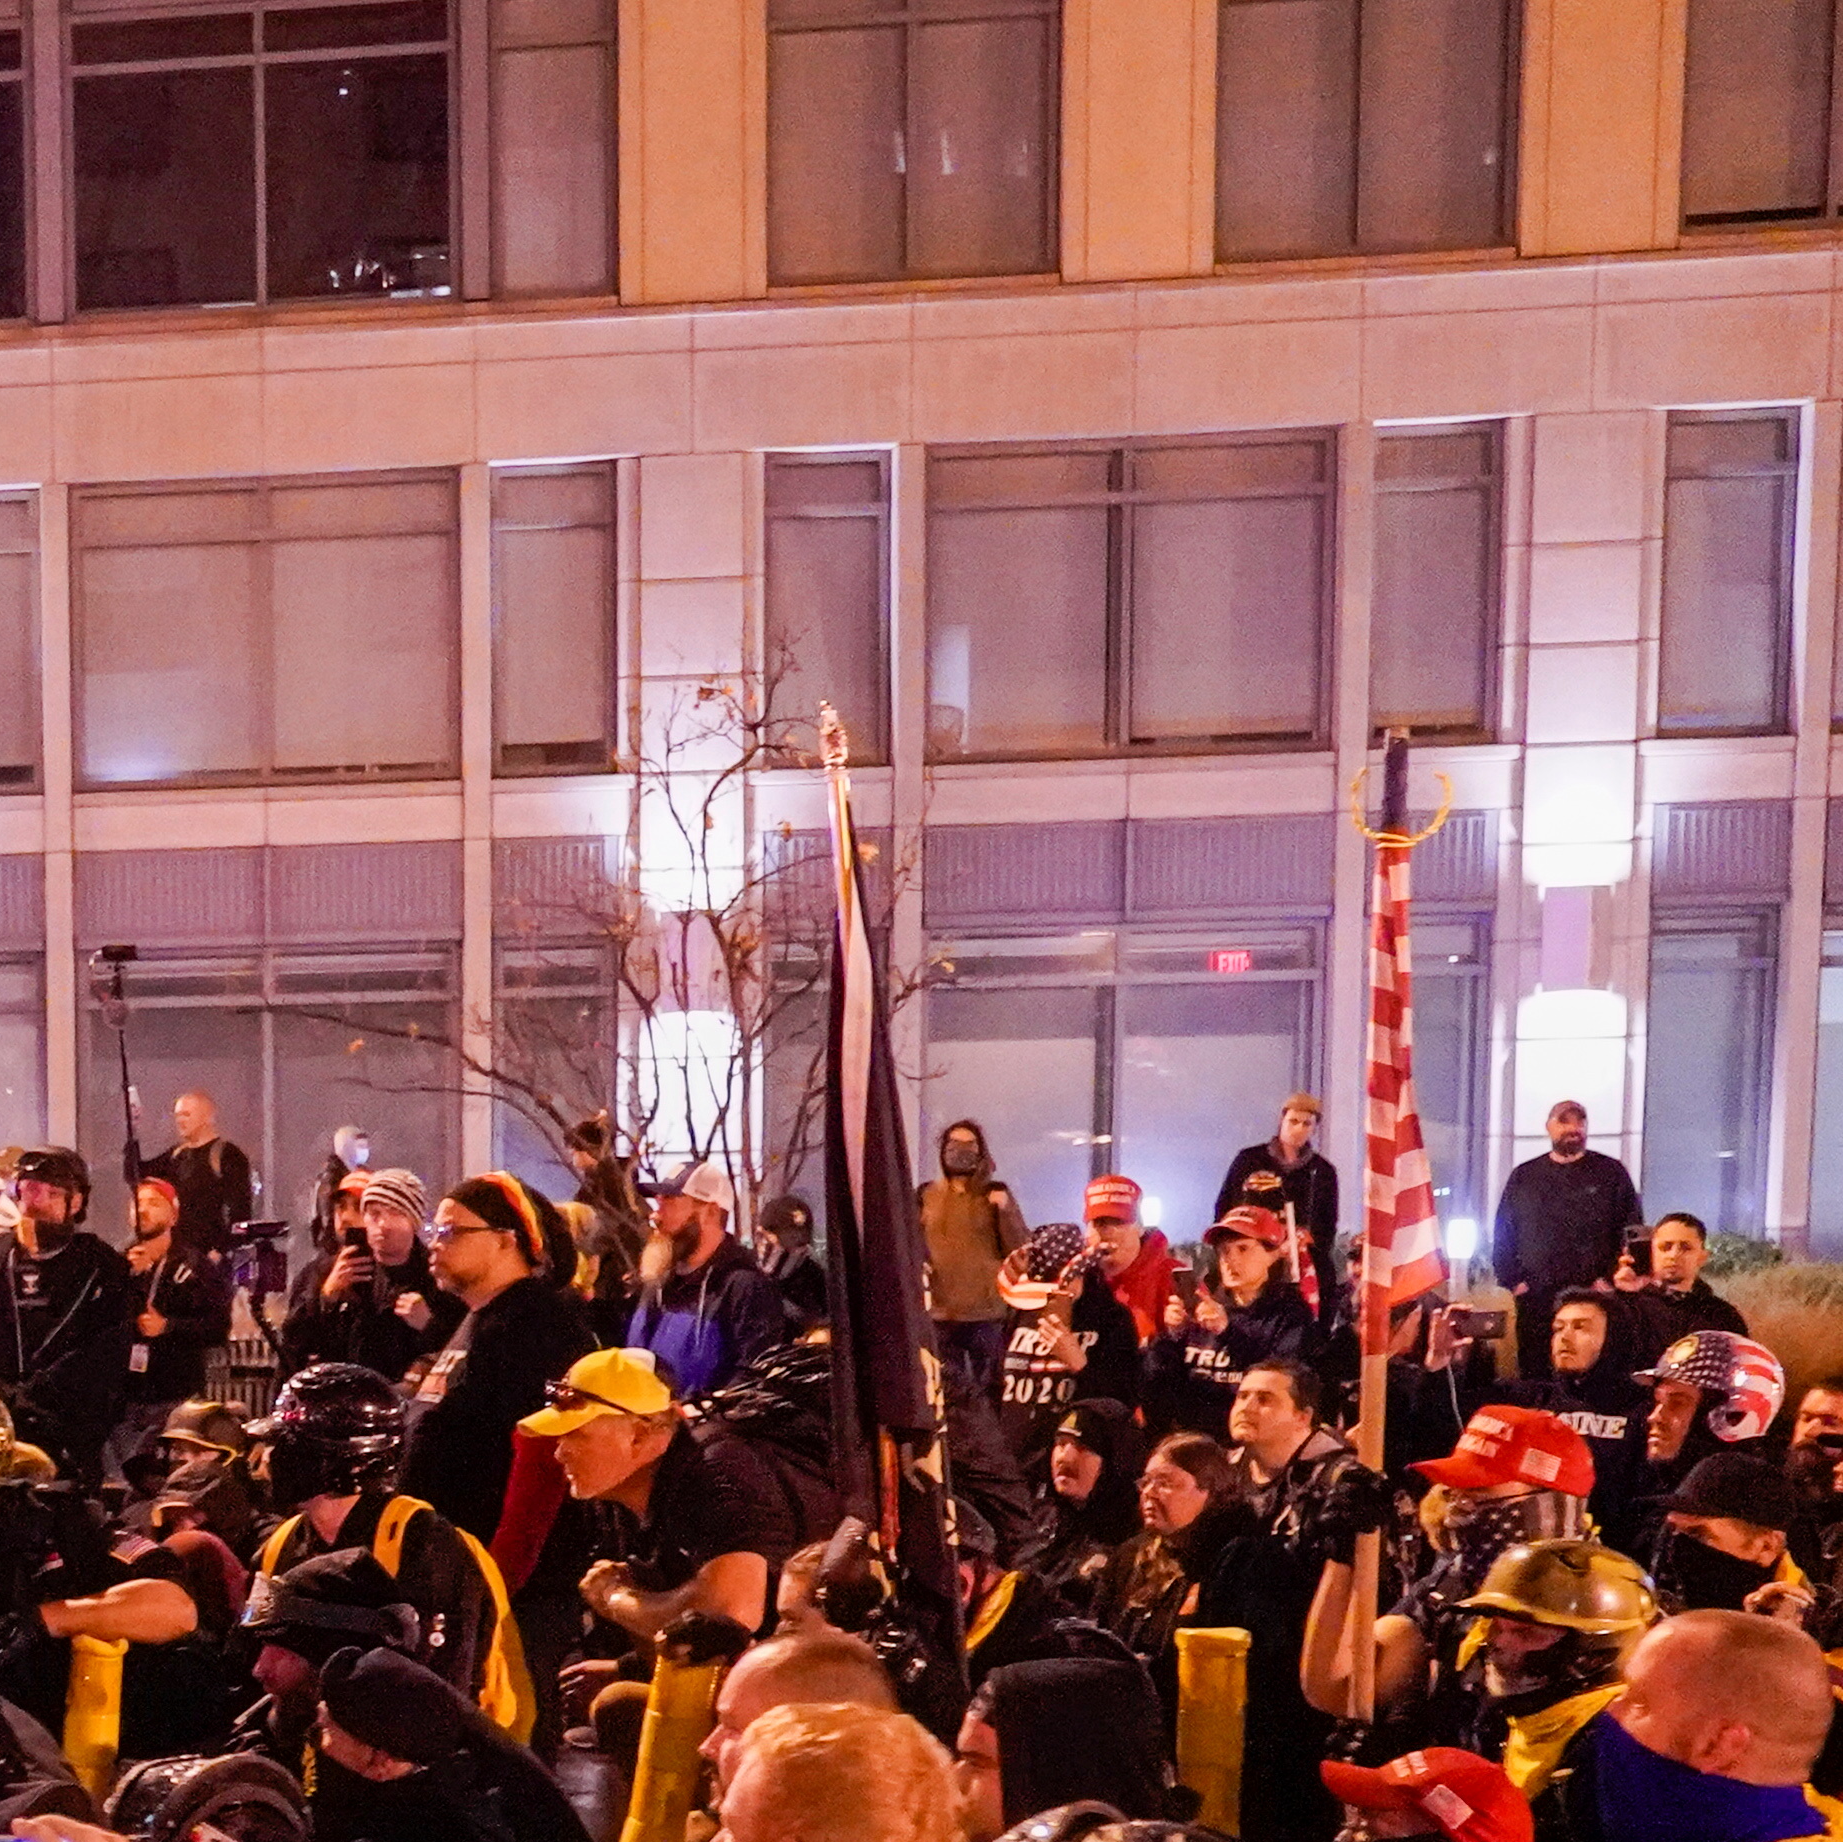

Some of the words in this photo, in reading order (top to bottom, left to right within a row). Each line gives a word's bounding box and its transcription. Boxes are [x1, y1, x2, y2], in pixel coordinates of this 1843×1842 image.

[1217, 953, 1247, 973] EXIT
[1008, 1327, 1099, 1356] TRUP
[1183, 1345, 1232, 1368] TRU
[1002, 1374, 1076, 1404] 2020
